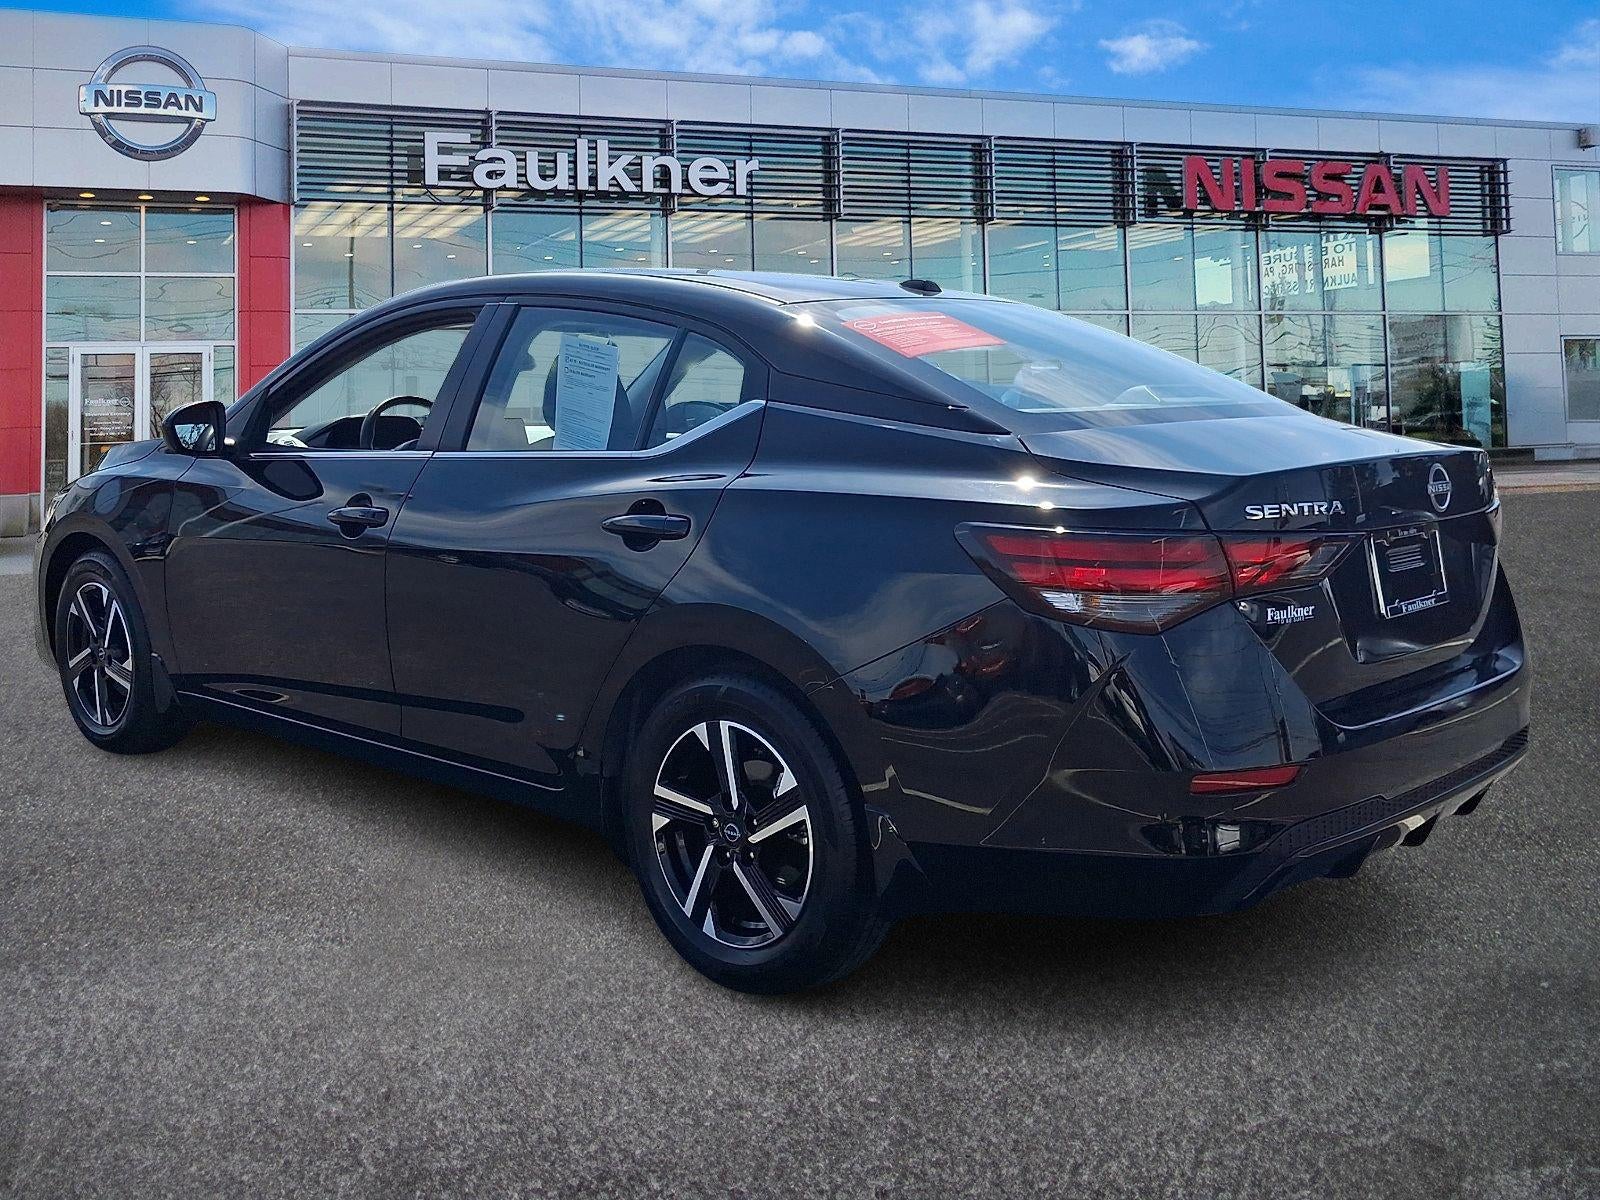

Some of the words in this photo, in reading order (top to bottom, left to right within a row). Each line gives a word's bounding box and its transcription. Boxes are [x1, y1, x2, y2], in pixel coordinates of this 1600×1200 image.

[94, 89, 204, 113] NISSAN
[423, 131, 760, 197] Faulkner
[1182, 154, 1451, 217] NISSAN
[1244, 501, 1345, 521] SENTRA
[1266, 605, 1315, 621] Faulkner
[1402, 598, 1436, 613] Faulkner
